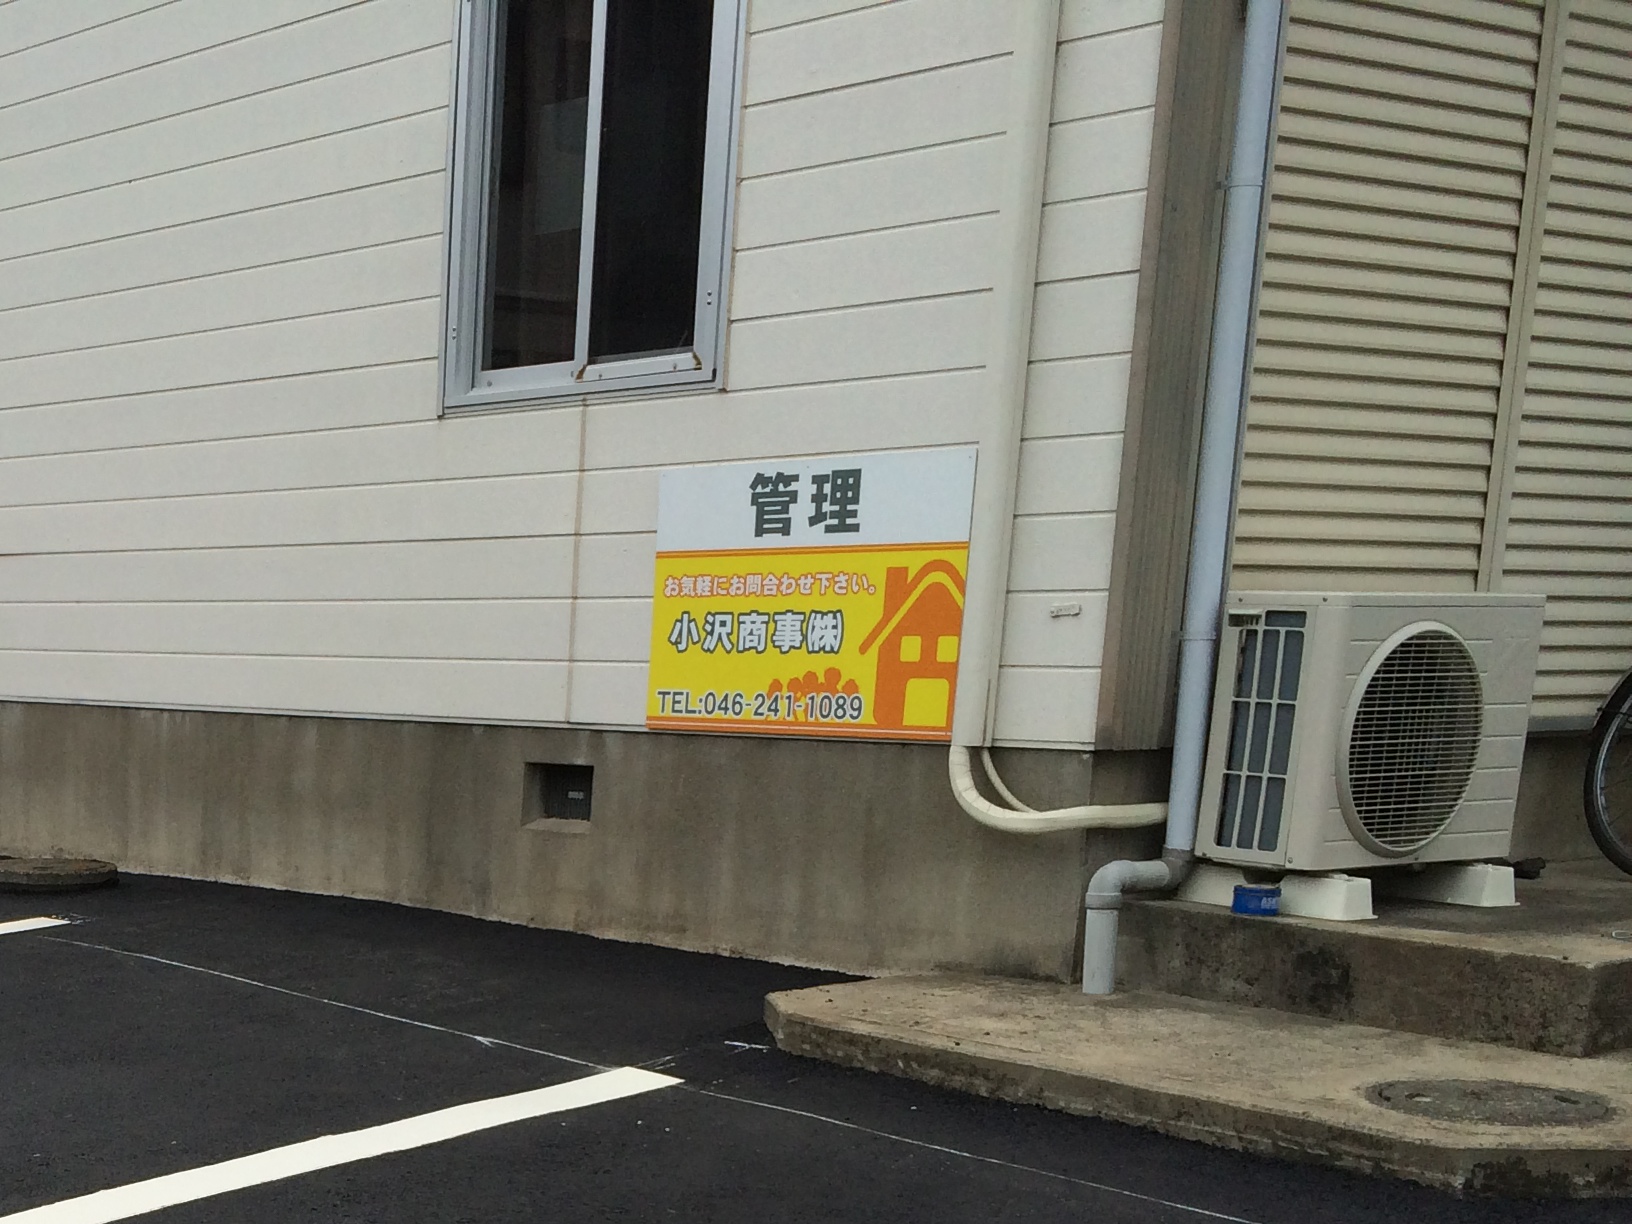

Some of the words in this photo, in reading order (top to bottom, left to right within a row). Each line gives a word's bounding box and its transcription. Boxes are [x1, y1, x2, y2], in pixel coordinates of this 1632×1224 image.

[749, 468, 862, 538] 管理
[664, 573, 876, 598] お気軽にお問合わせ下さい。
[656, 690, 864, 721] TEL:046-241-1089
